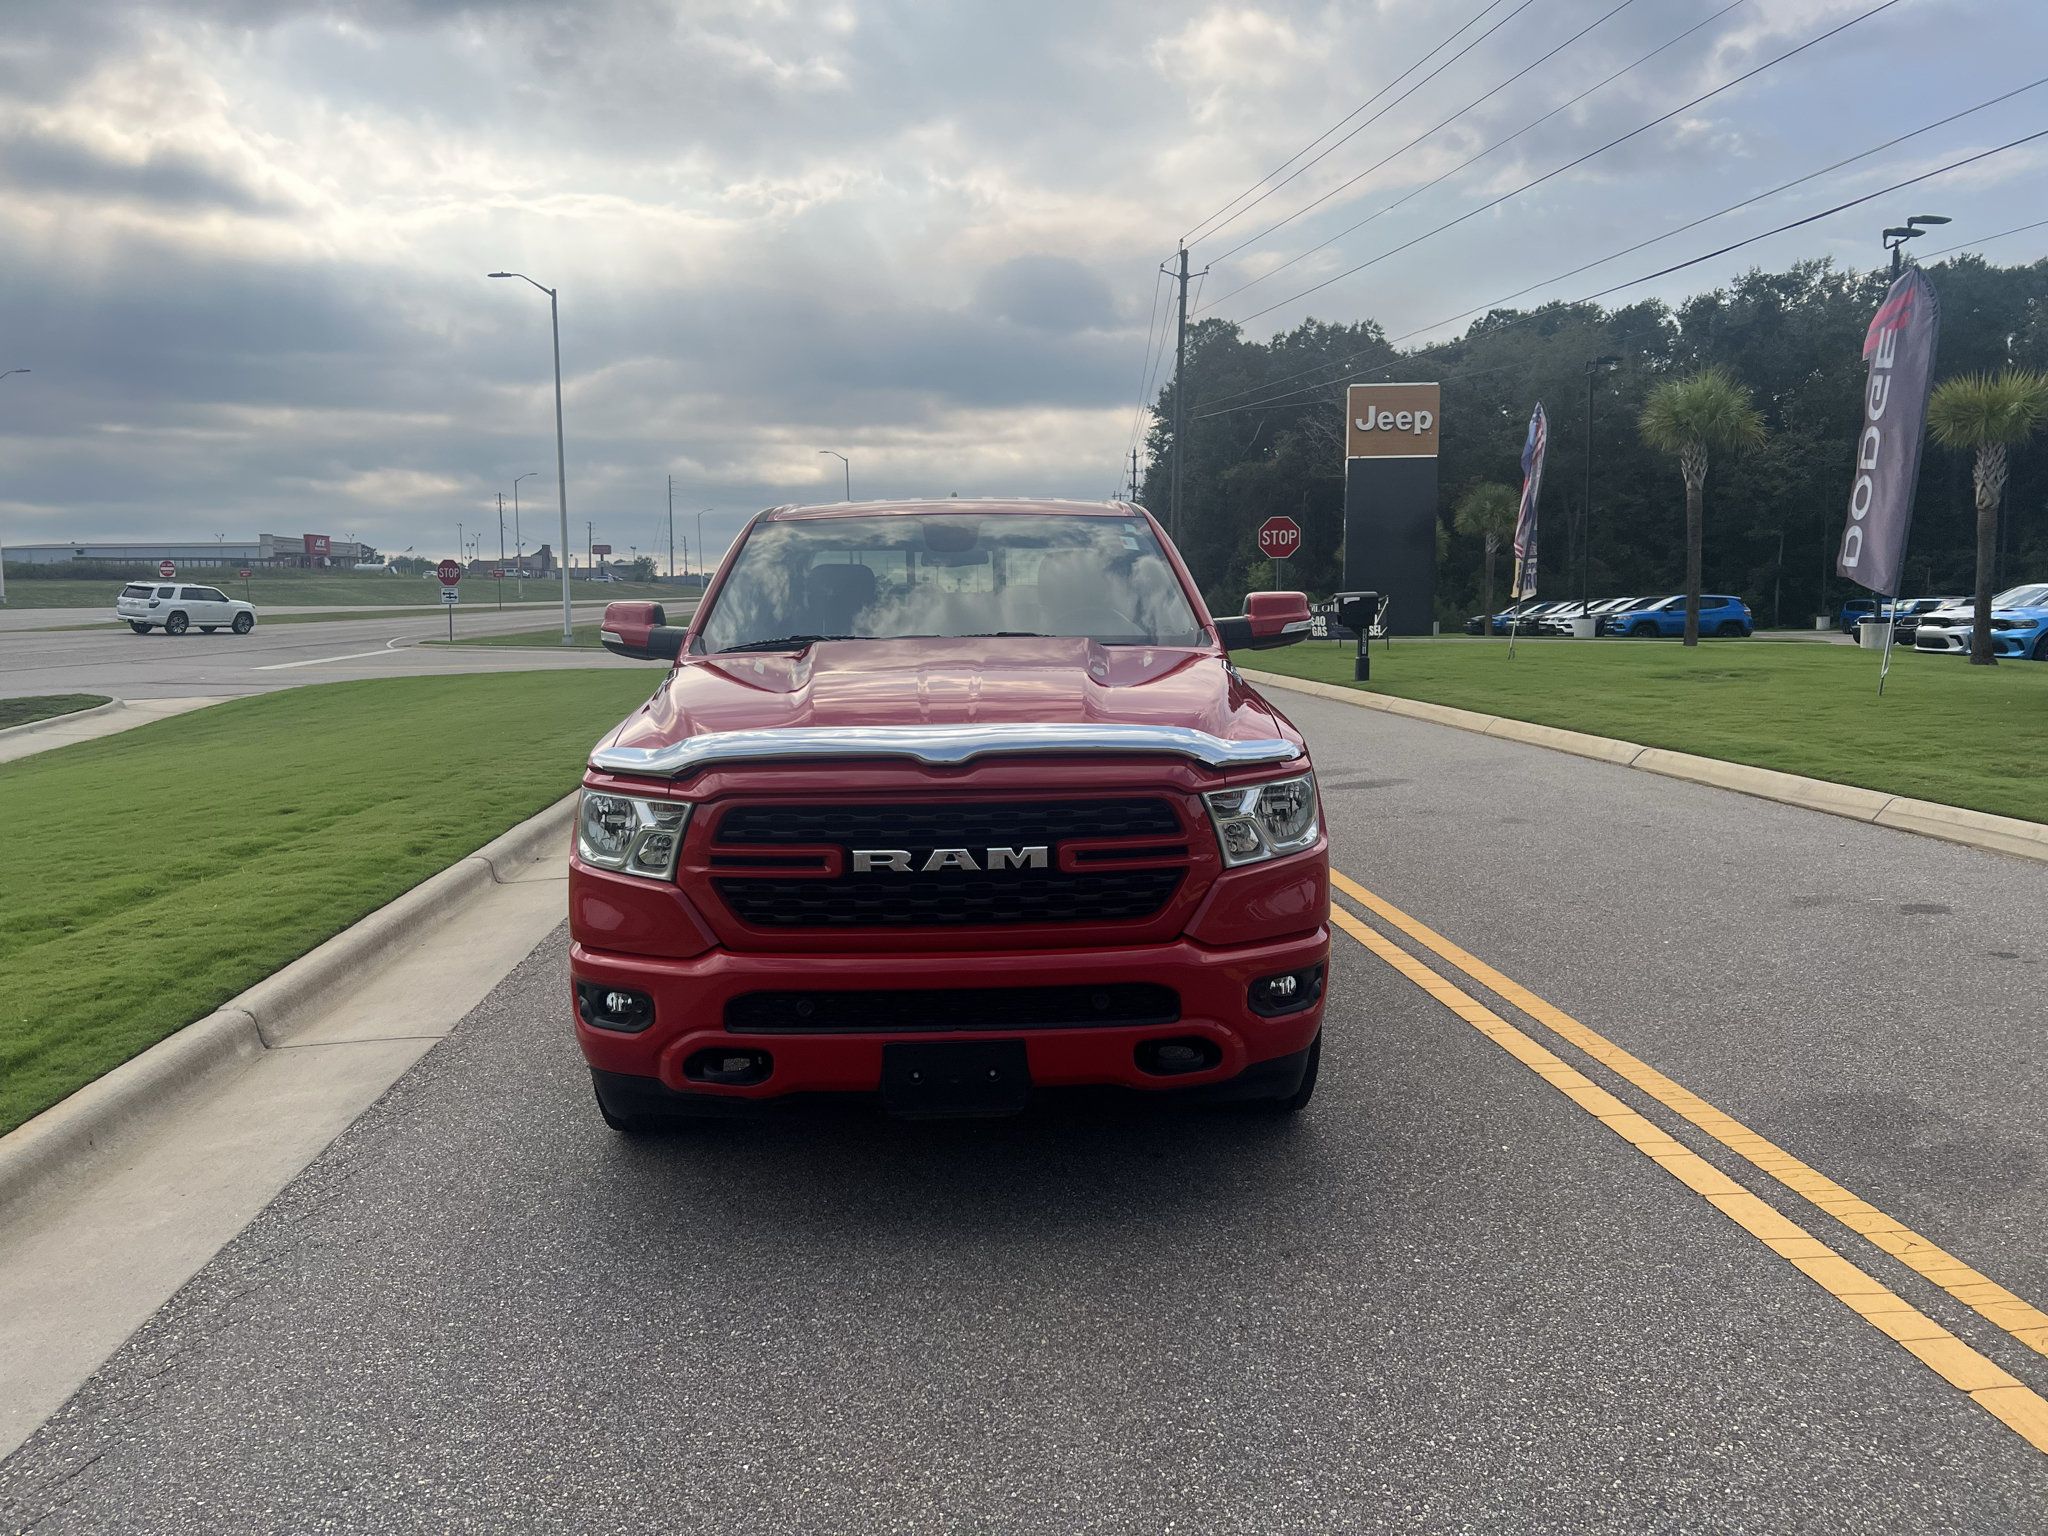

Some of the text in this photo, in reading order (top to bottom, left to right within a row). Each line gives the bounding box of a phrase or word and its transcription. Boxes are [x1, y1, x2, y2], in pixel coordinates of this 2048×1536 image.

[1355, 405, 1434, 435] Jeep
[1843, 327, 1898, 568] DODGE
[1262, 530, 1298, 545] STOP
[438, 567, 460, 578] STOP
[1312, 626, 1328, 637] GAS
[852, 846, 1048, 872] RAM
